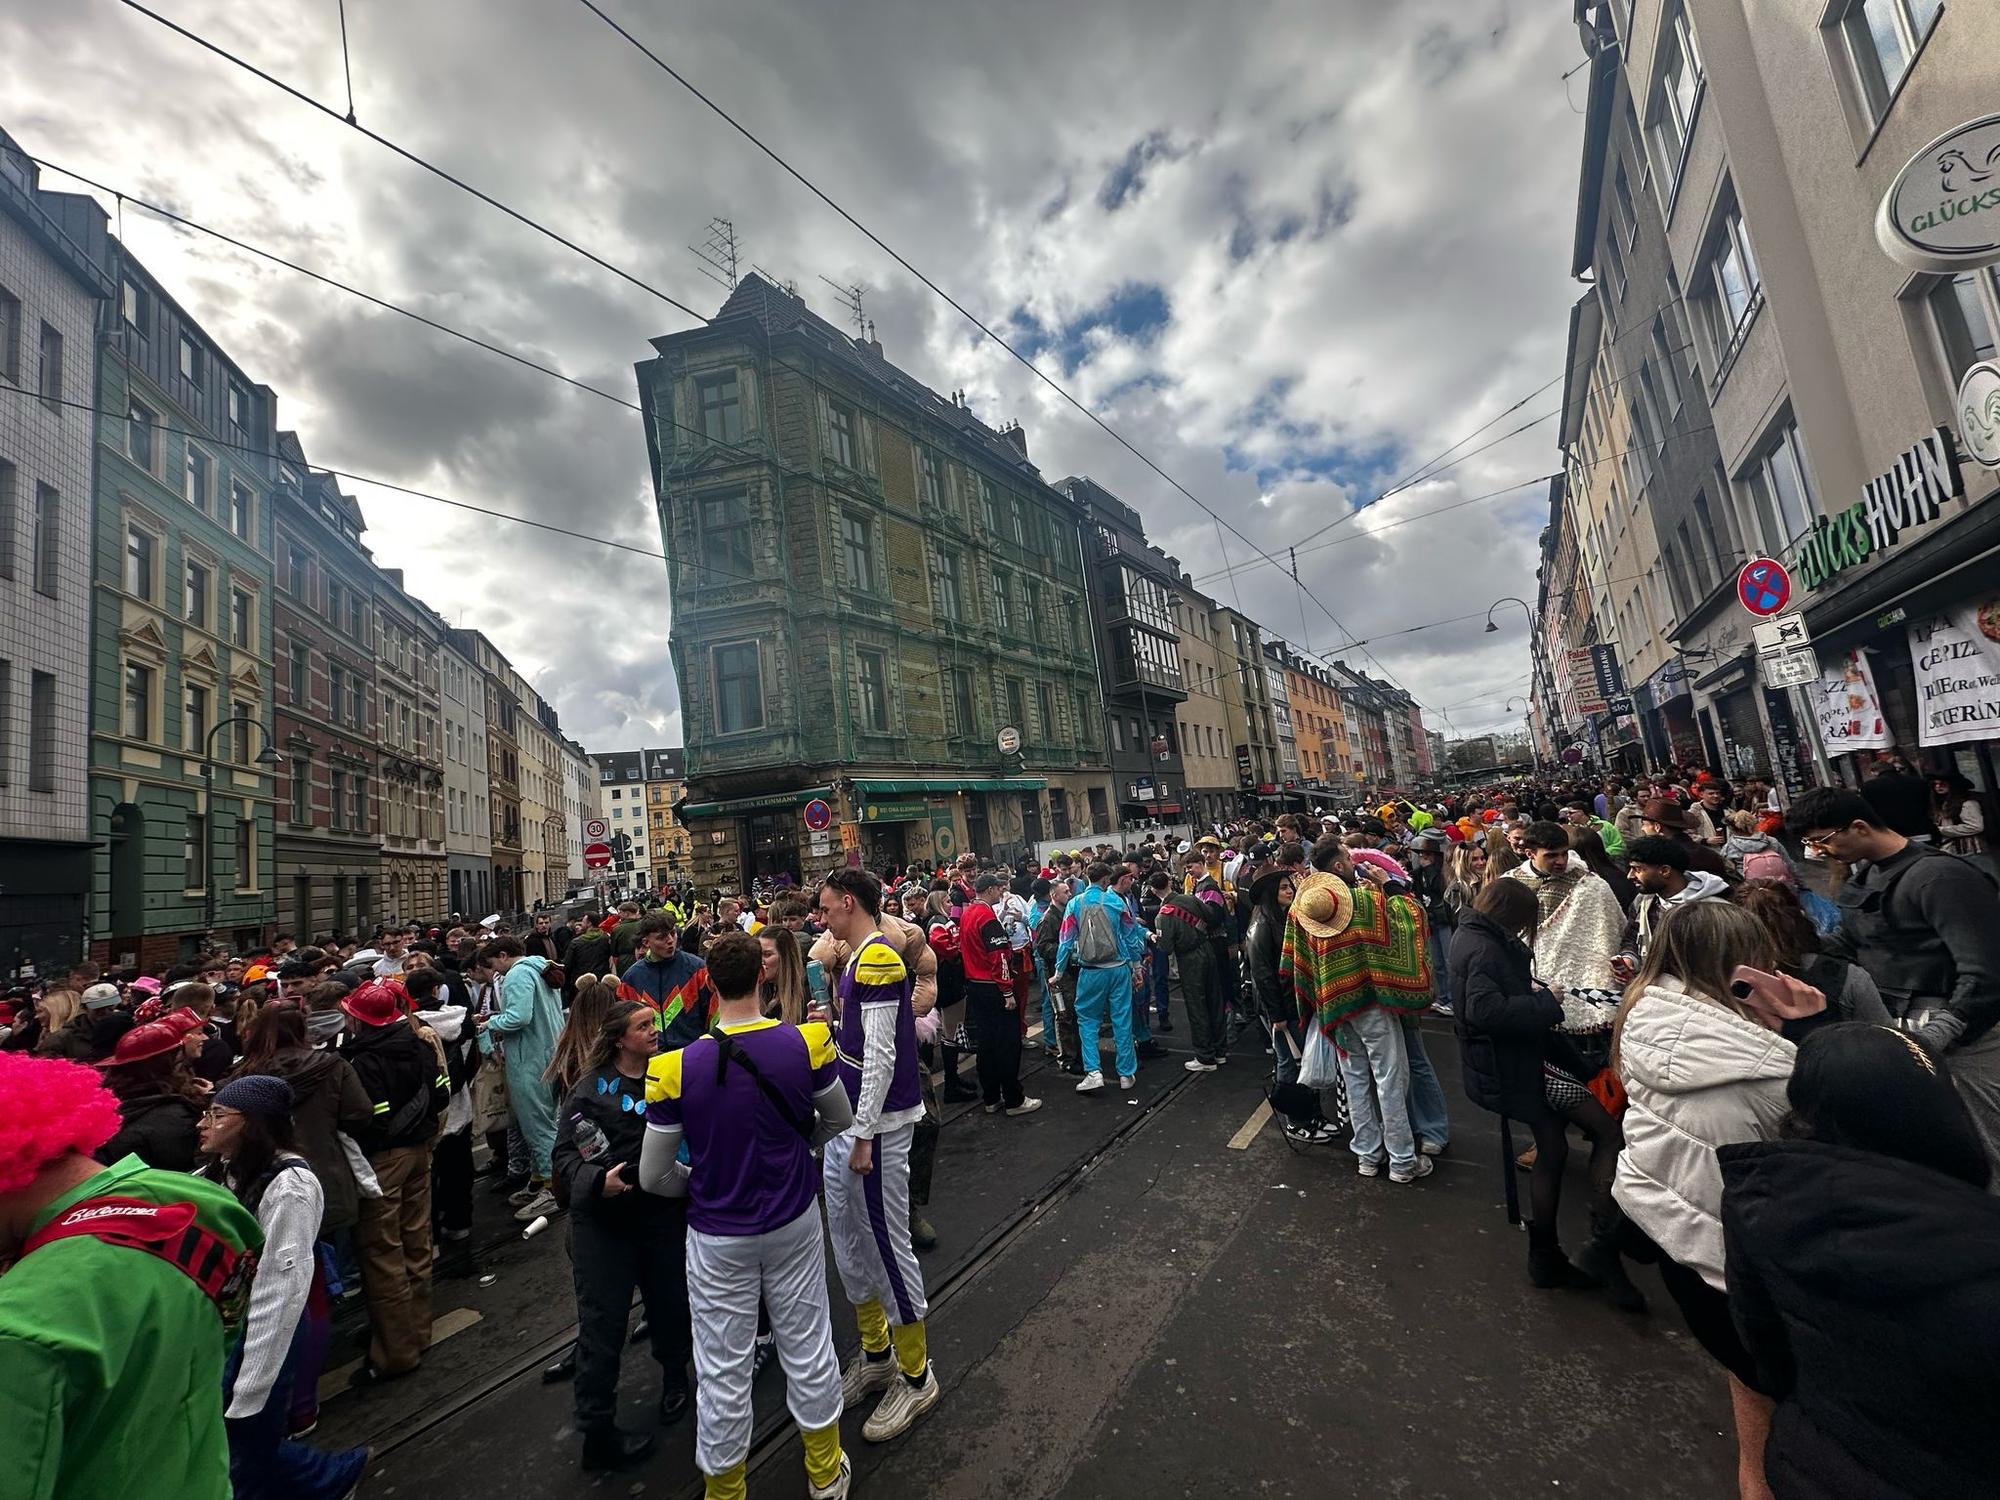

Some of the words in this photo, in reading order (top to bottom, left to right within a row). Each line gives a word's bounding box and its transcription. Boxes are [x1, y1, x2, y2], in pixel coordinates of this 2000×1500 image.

[1611, 704, 1629, 712] sky
[590, 824, 602, 833] 30
[62, 1205, 158, 1226] Berentzen
